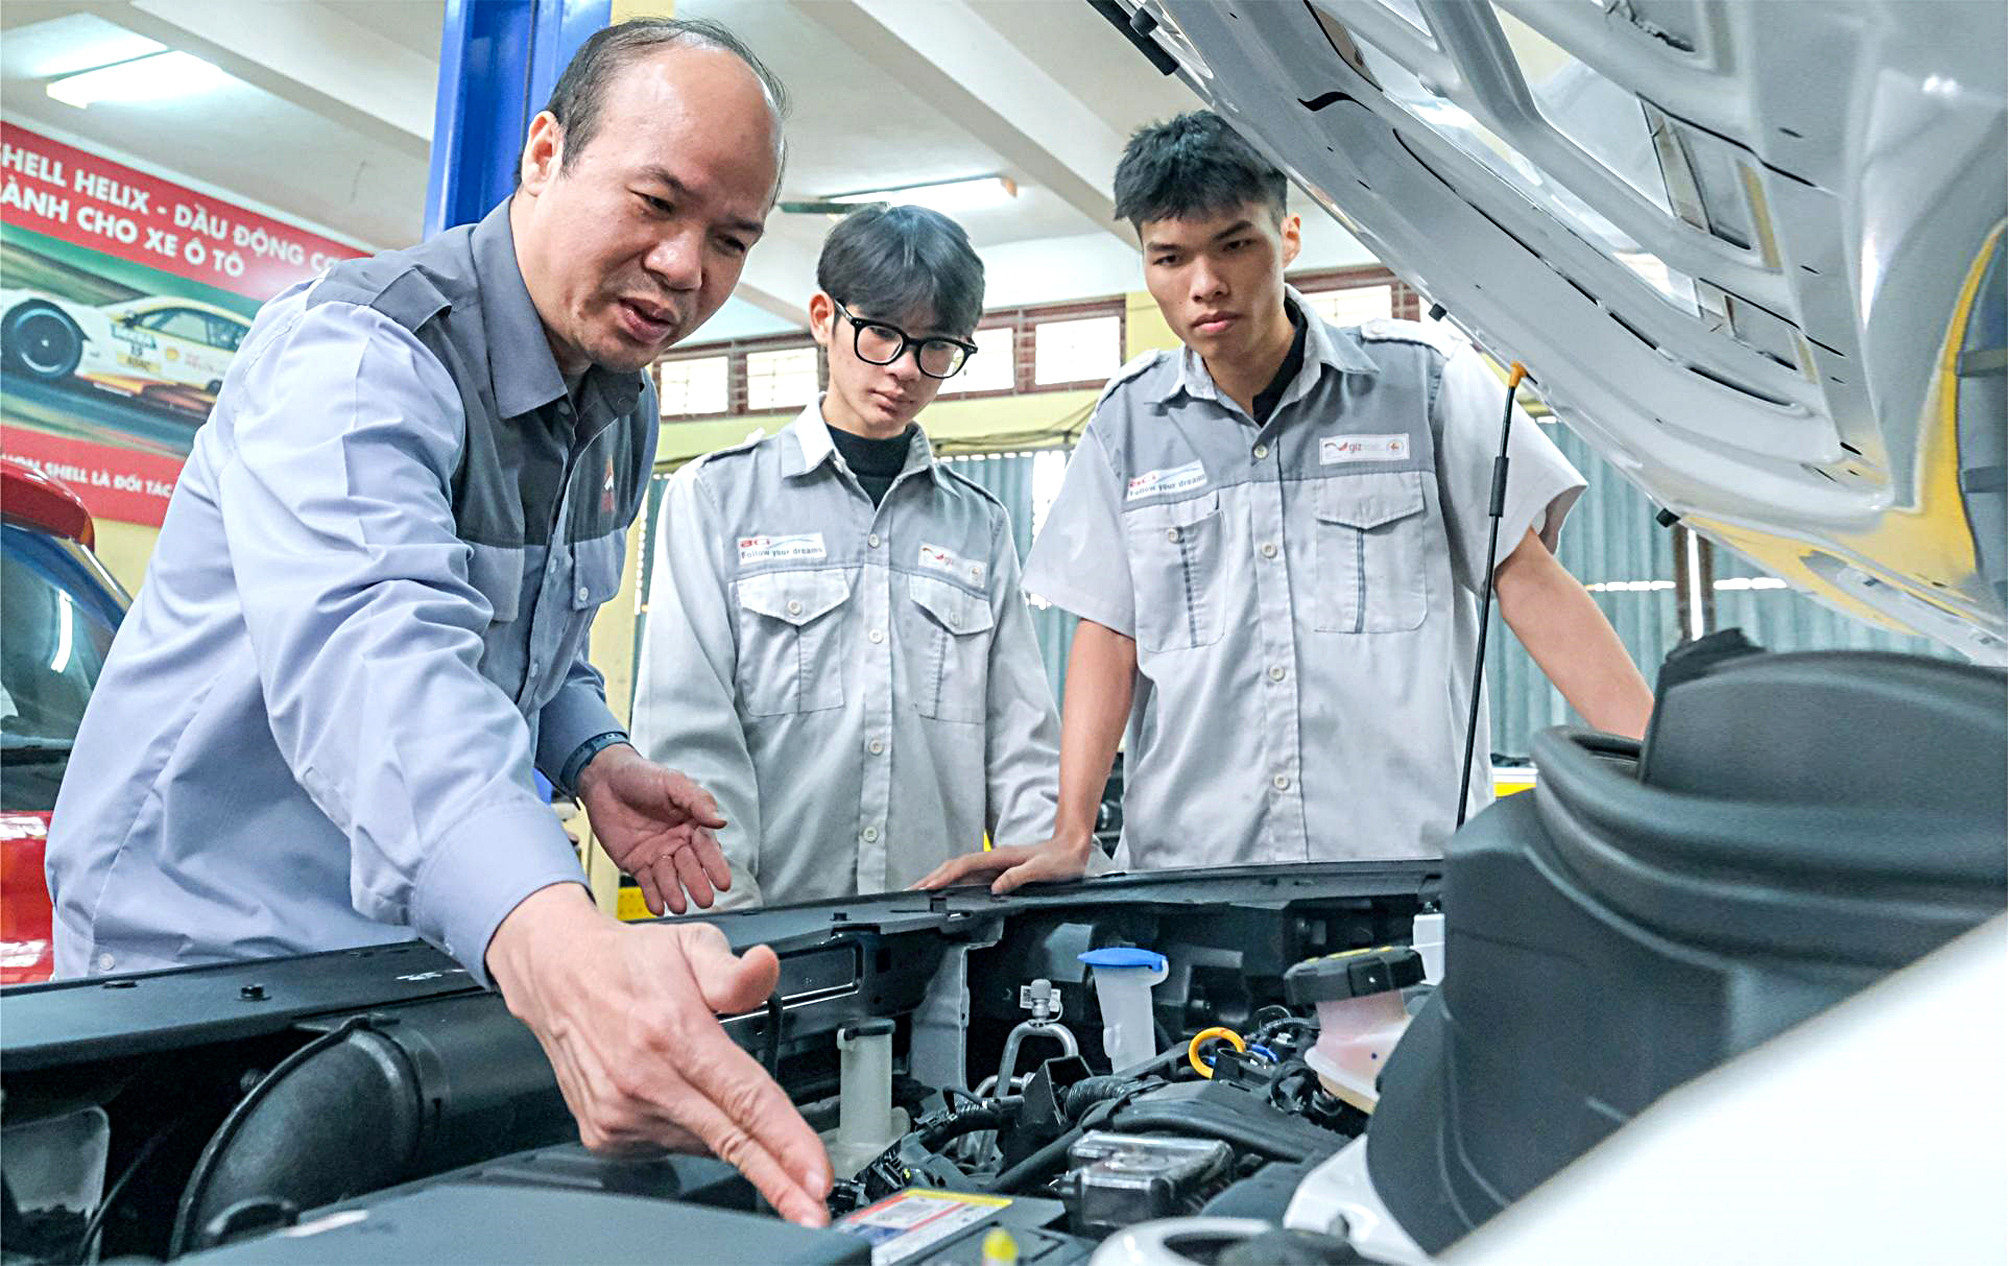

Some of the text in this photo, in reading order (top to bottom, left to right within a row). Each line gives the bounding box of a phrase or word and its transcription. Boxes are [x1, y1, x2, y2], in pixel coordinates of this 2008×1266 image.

[0, 143, 67, 187] HELL
[74, 169, 149, 215] HELIX
[232, 224, 304, 266] ĐỘNG
[0, 175, 245, 277] ÀNH CHO XE Ô TÔ
[91, 468, 110, 487] LÀ
[741, 547, 822, 559] Follow your dreams
